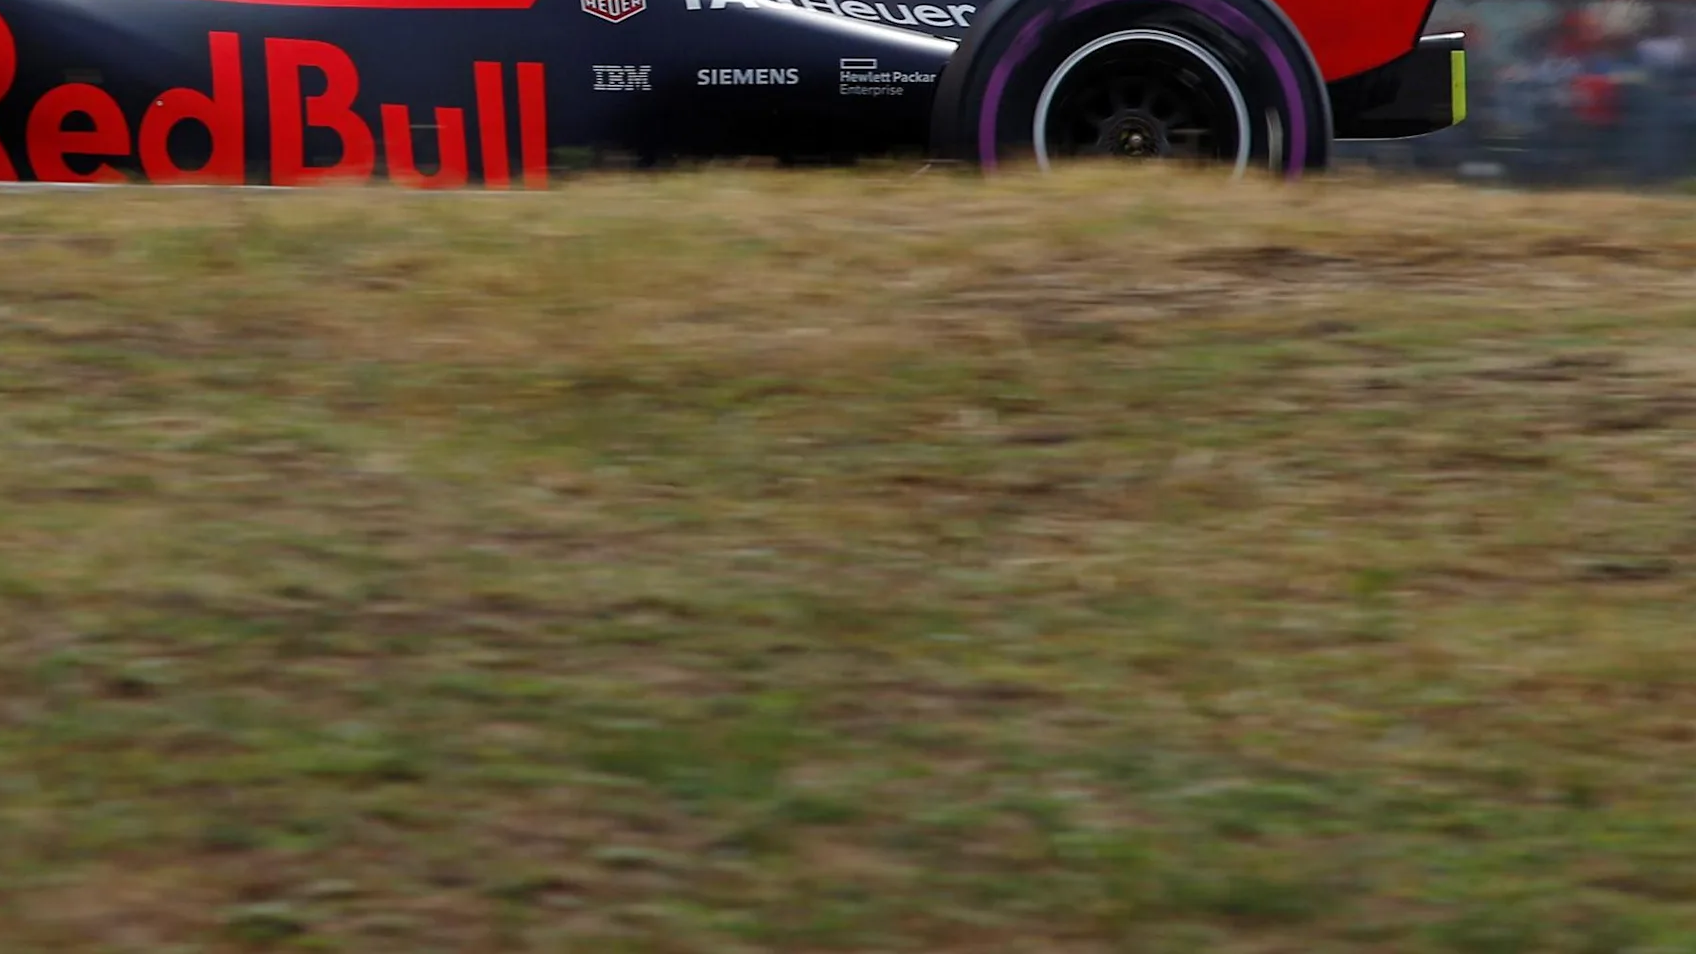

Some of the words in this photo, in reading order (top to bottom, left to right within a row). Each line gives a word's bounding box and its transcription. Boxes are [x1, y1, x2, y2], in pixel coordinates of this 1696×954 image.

[592, 65, 652, 91] IBM
[697, 68, 800, 85] SIEMENS
[840, 71, 891, 83] Hewlett
[892, 71, 937, 83] Packar
[840, 84, 904, 97] Enterprise
